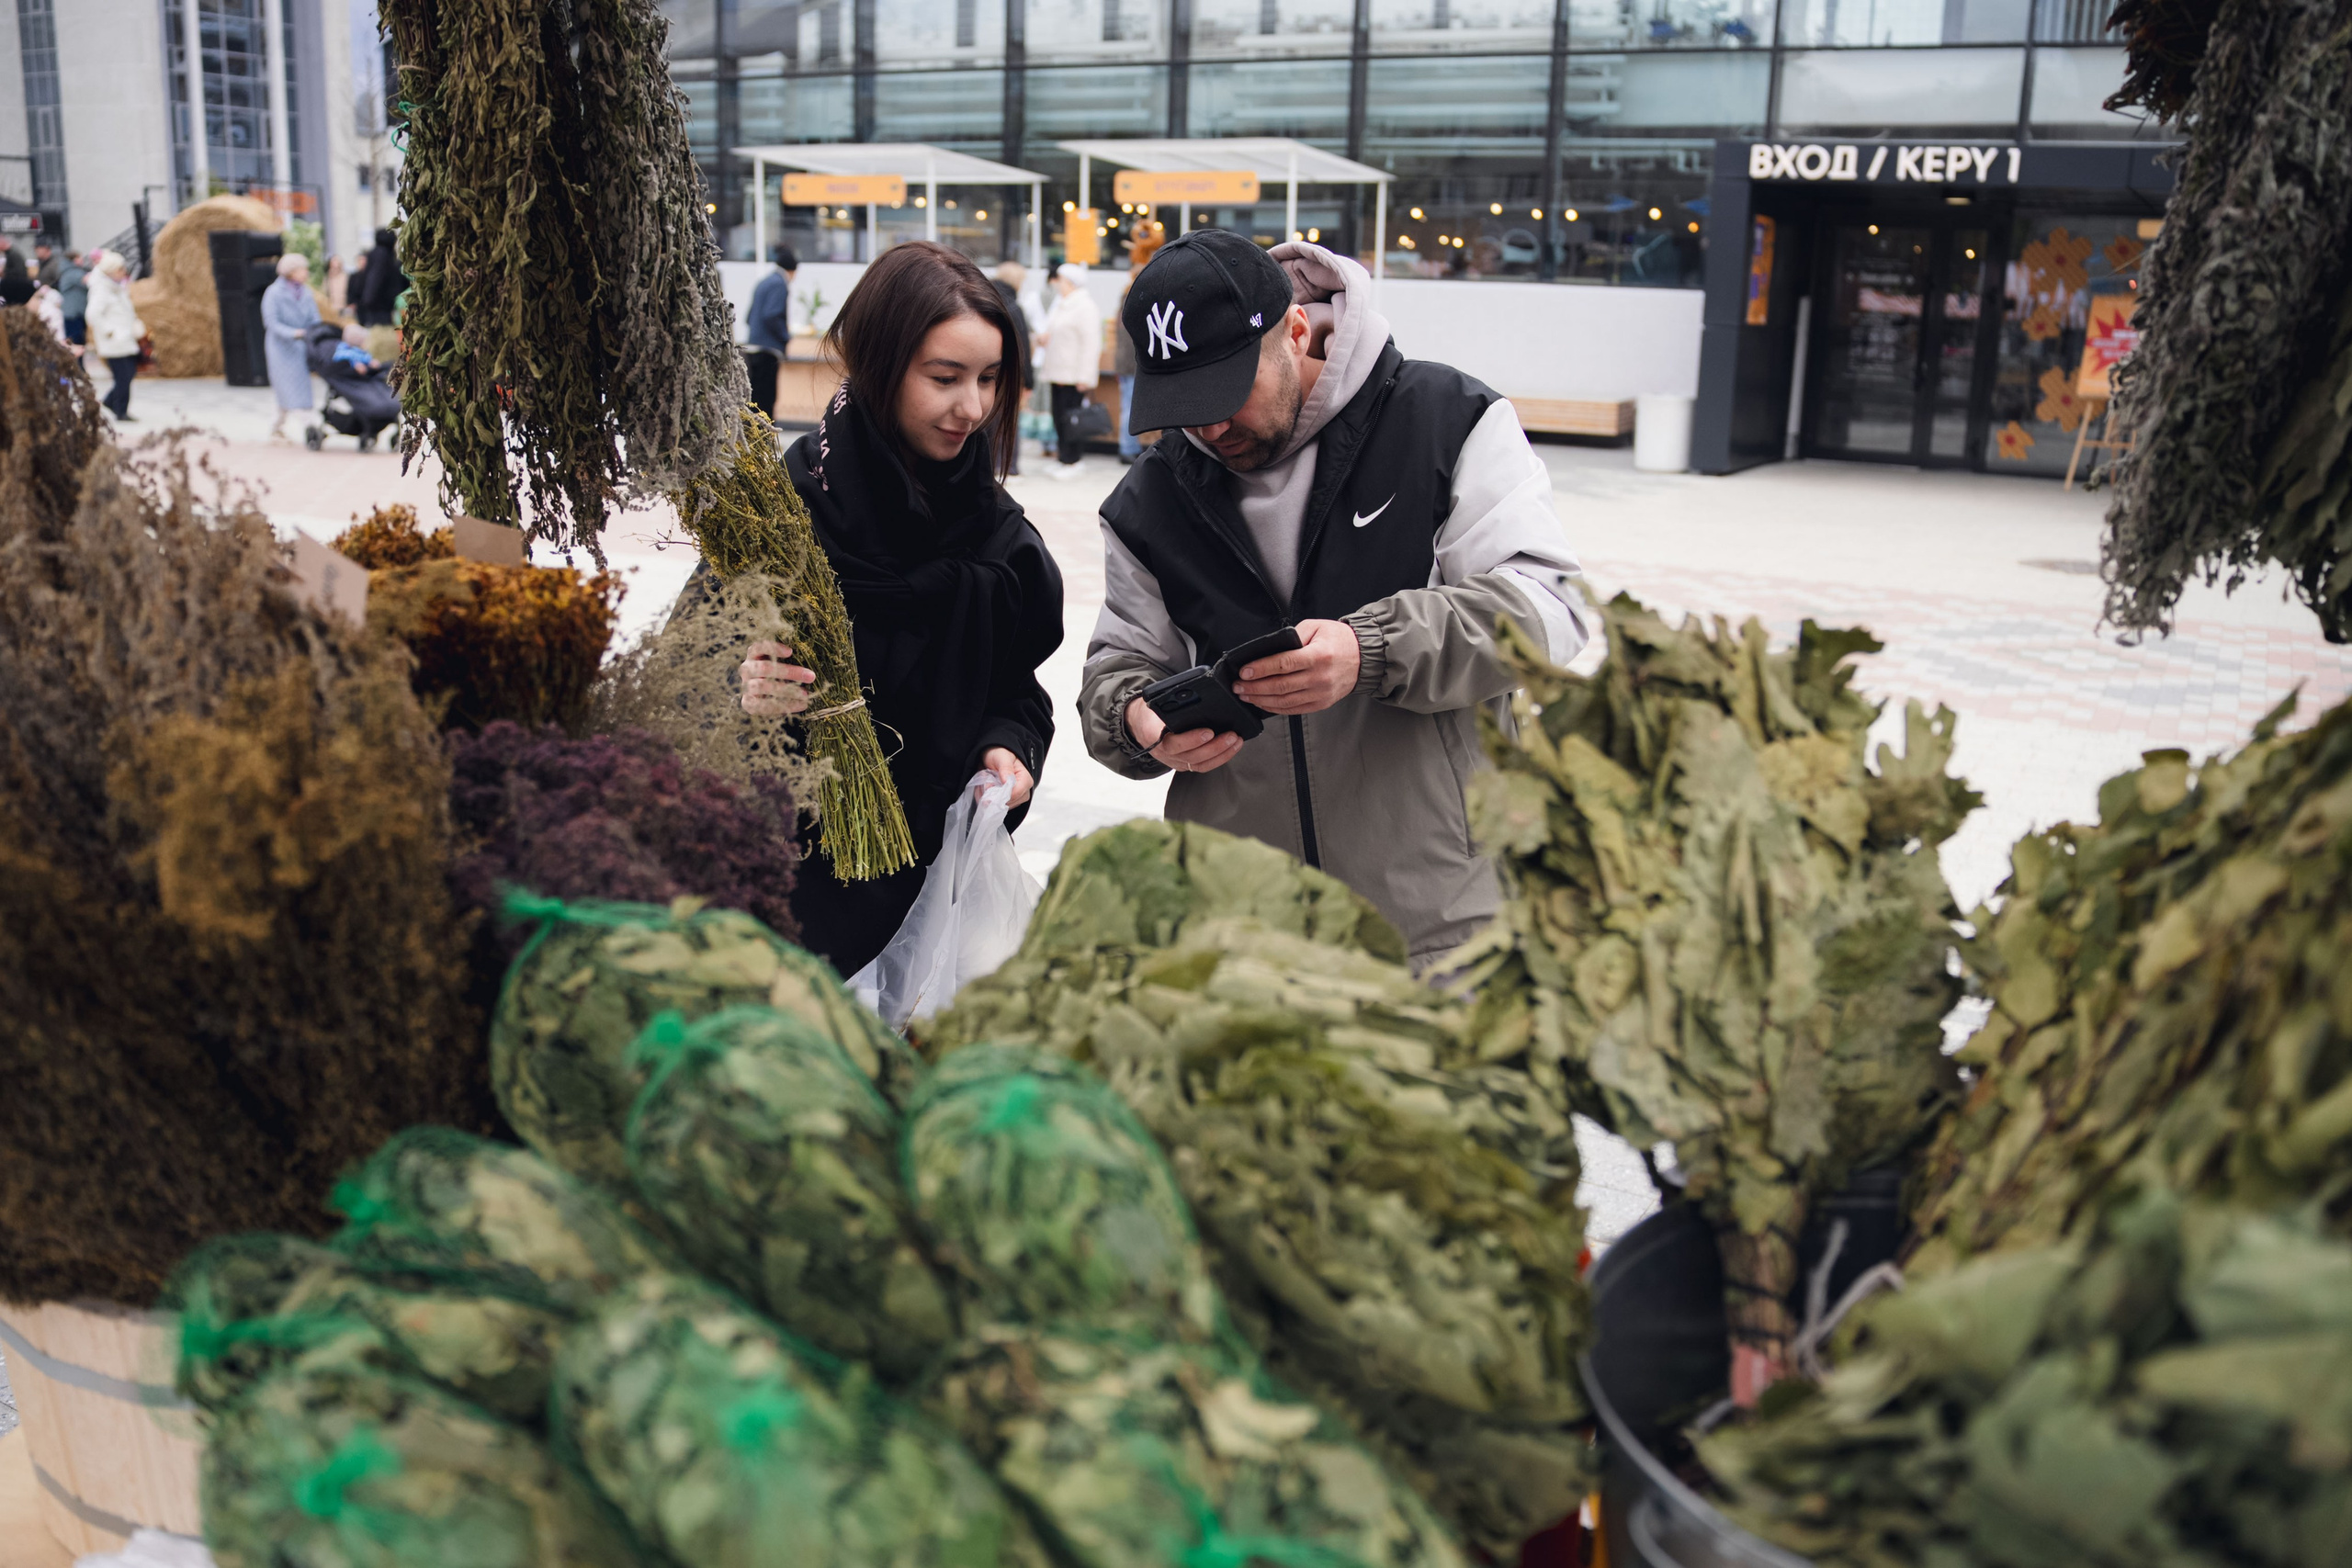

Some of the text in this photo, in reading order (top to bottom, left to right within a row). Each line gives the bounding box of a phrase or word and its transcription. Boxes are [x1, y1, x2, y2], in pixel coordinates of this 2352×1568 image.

[1748, 143, 1859, 181] ВХОД
[1866, 145, 1888, 182] /
[2007, 147, 2021, 184] 1
[1146, 300, 1189, 360] NY
